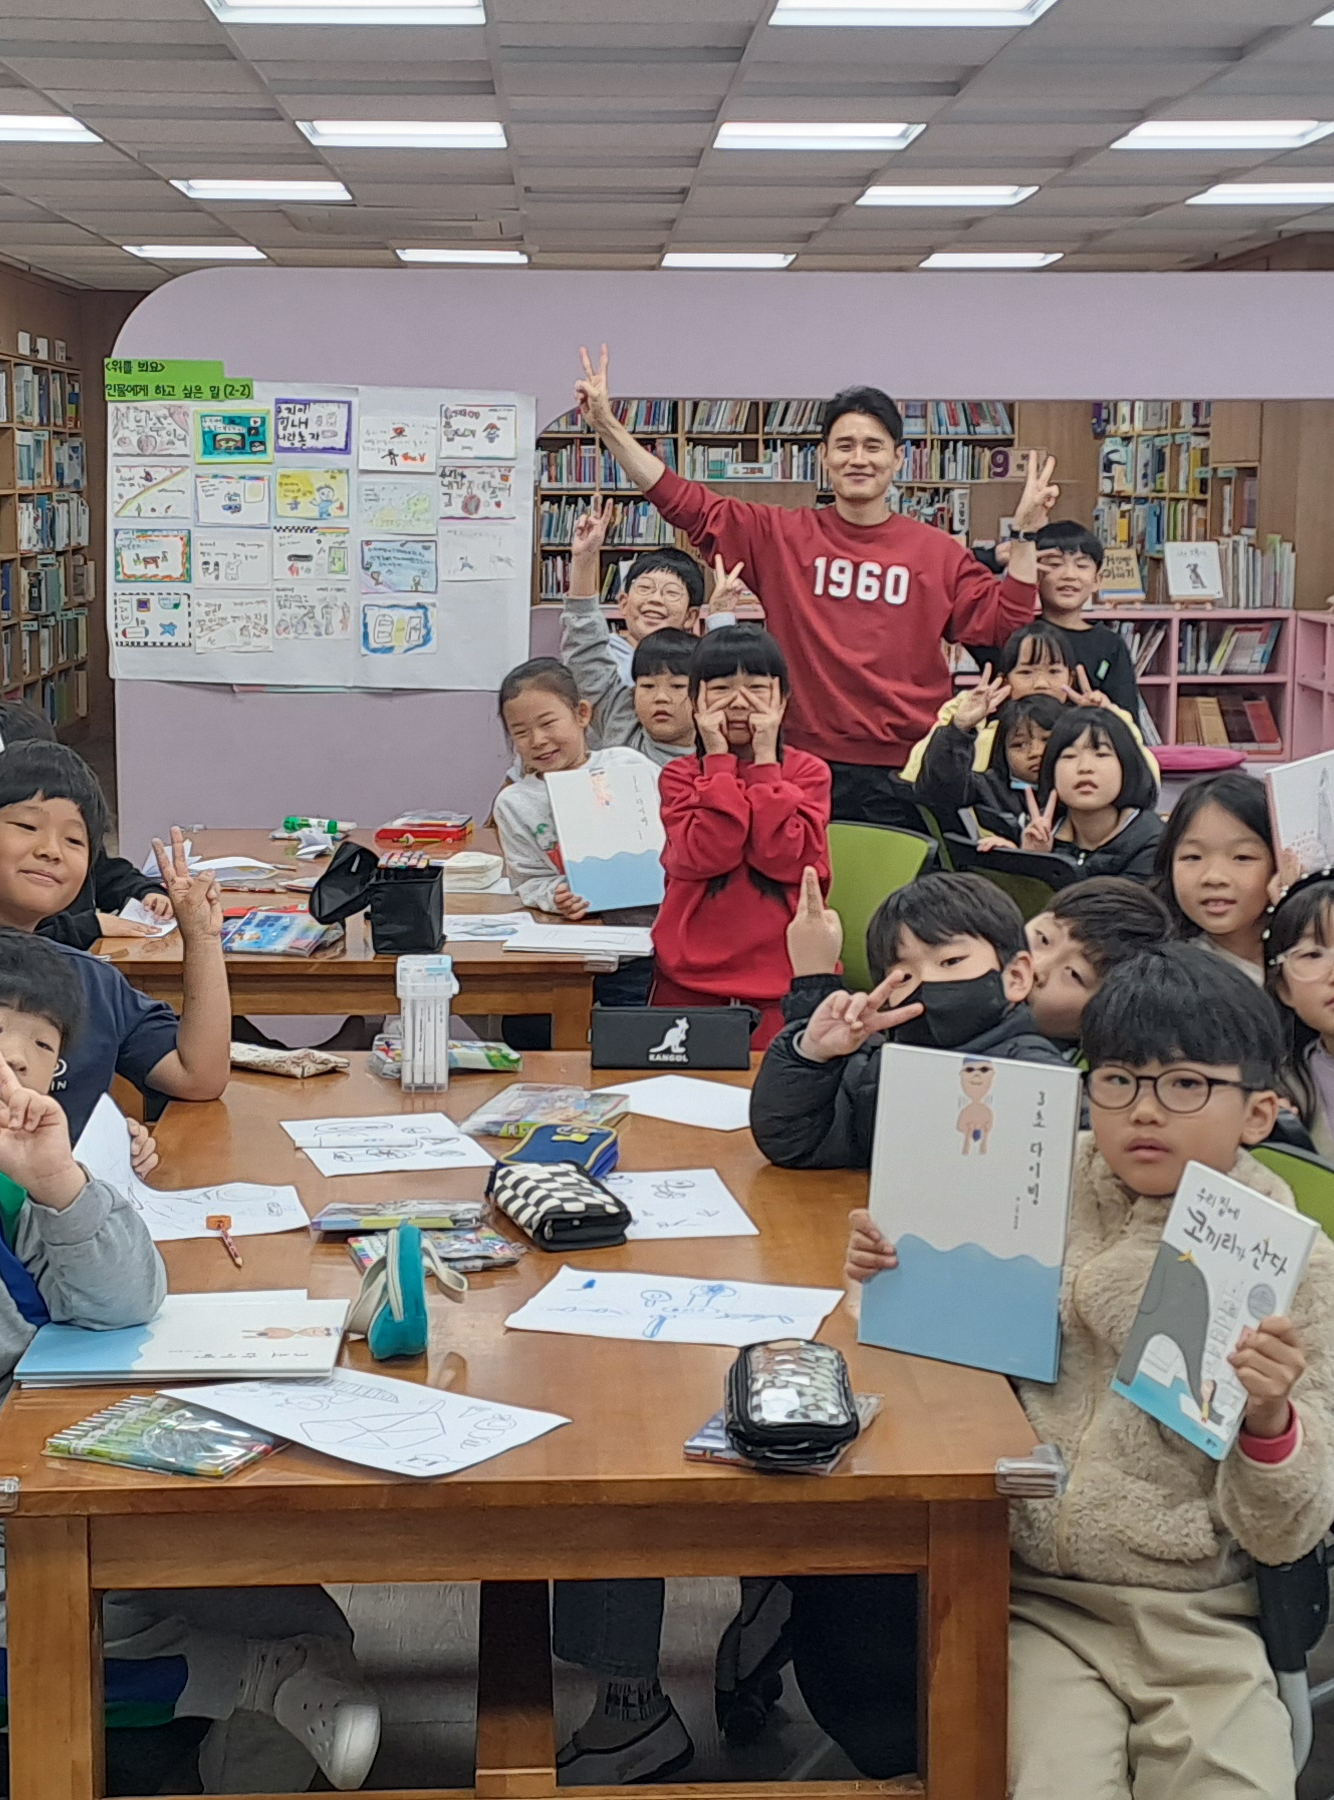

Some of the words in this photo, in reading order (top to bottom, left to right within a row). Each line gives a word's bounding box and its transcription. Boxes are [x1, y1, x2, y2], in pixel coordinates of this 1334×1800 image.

[155, 384, 176, 397] 하고
[182, 385, 204, 399] 싶은
[990, 449, 1011, 478] 9
[814, 556, 910, 605] 1960
[1032, 1091, 1046, 1128] 3초
[1027, 1142, 1044, 1205] 다이빙
[1197, 1187, 1217, 1208] 우리
[1218, 1196, 1240, 1220] 집에
[1183, 1206, 1246, 1262] 코끼리가
[1251, 1238, 1288, 1277] 산다
